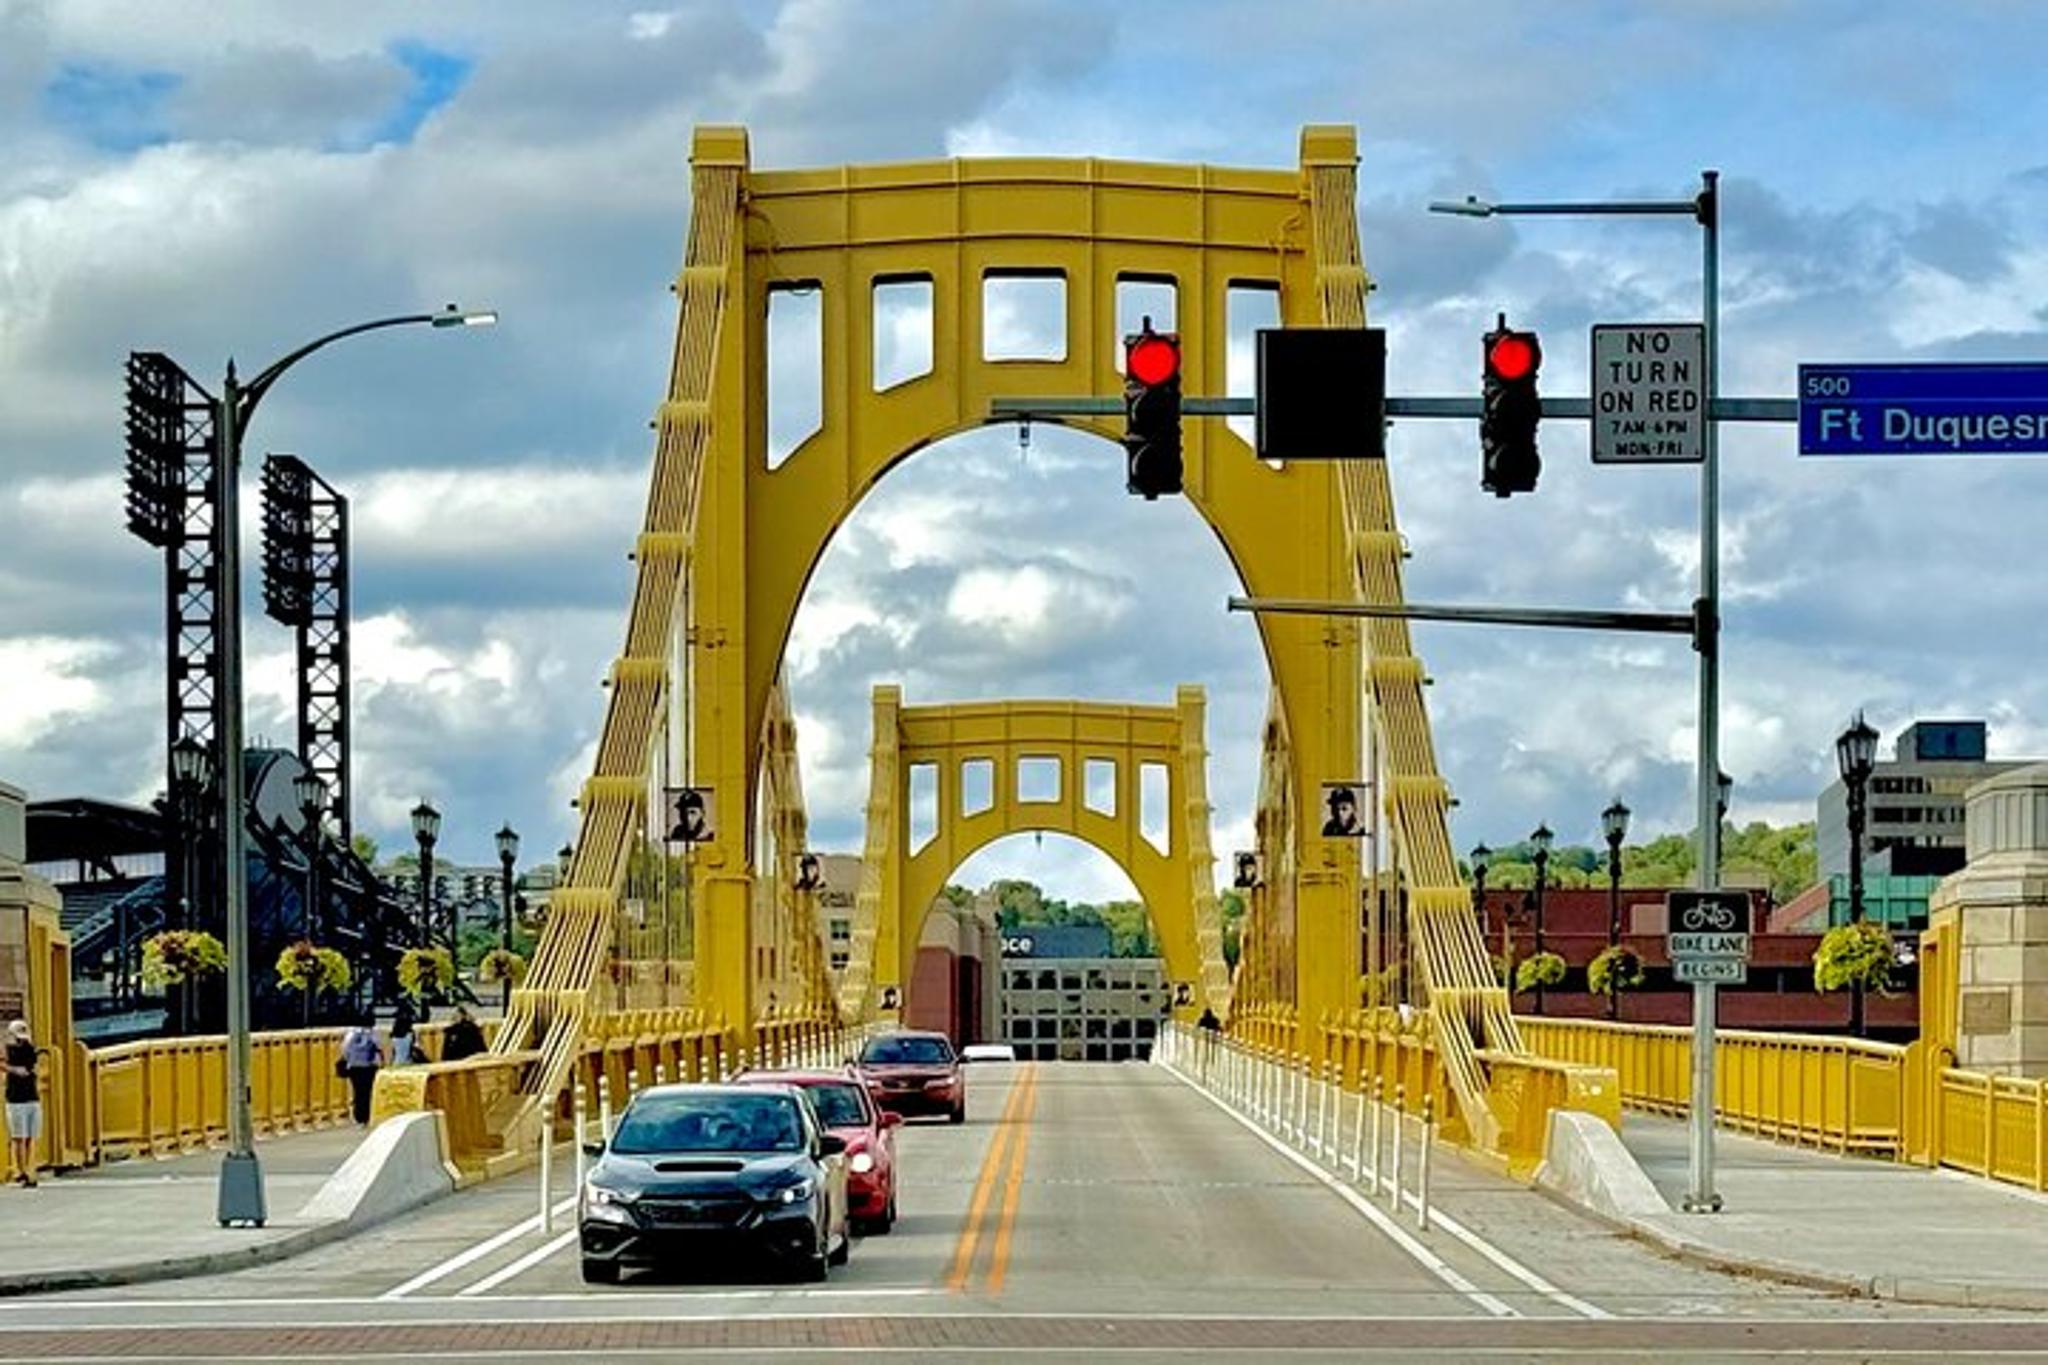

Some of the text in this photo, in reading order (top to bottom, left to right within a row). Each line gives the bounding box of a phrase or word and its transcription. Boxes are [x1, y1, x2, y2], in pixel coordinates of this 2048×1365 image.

[1627, 332, 1670, 354] NO
[1609, 361, 1688, 383] TURN
[1806, 376, 1851, 395] 500
[1600, 390, 1698, 413] ON RED
[1819, 408, 1863, 442] Ft
[1672, 936, 1745, 952] BIKE LANE
